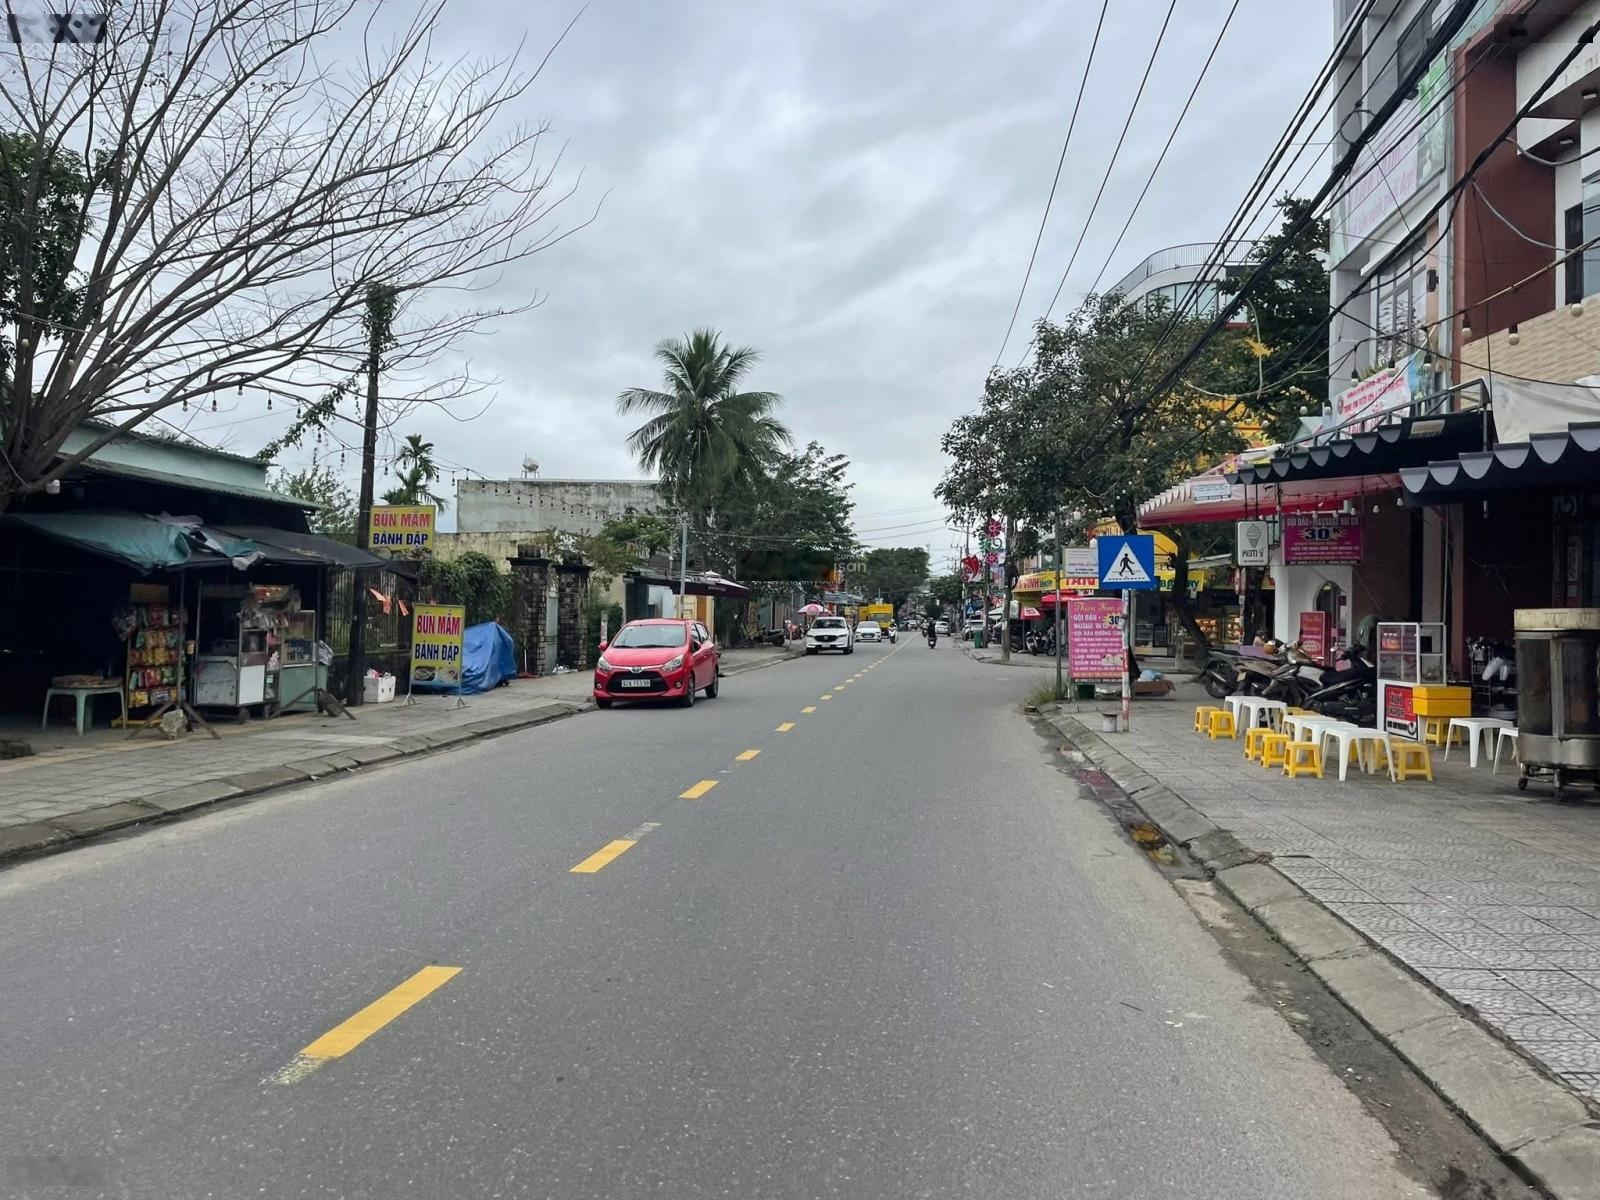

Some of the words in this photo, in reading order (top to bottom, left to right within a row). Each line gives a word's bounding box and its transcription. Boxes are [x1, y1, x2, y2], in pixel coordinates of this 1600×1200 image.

[373, 510, 397, 527] BÚN
[373, 531, 403, 545] BÁNH
[405, 531, 429, 549] ĐẬP
[416, 611, 435, 635] BÚN
[437, 609, 460, 636] MẮM
[414, 640, 439, 660] BÁNH
[441, 641, 459, 664] ĐẬP
